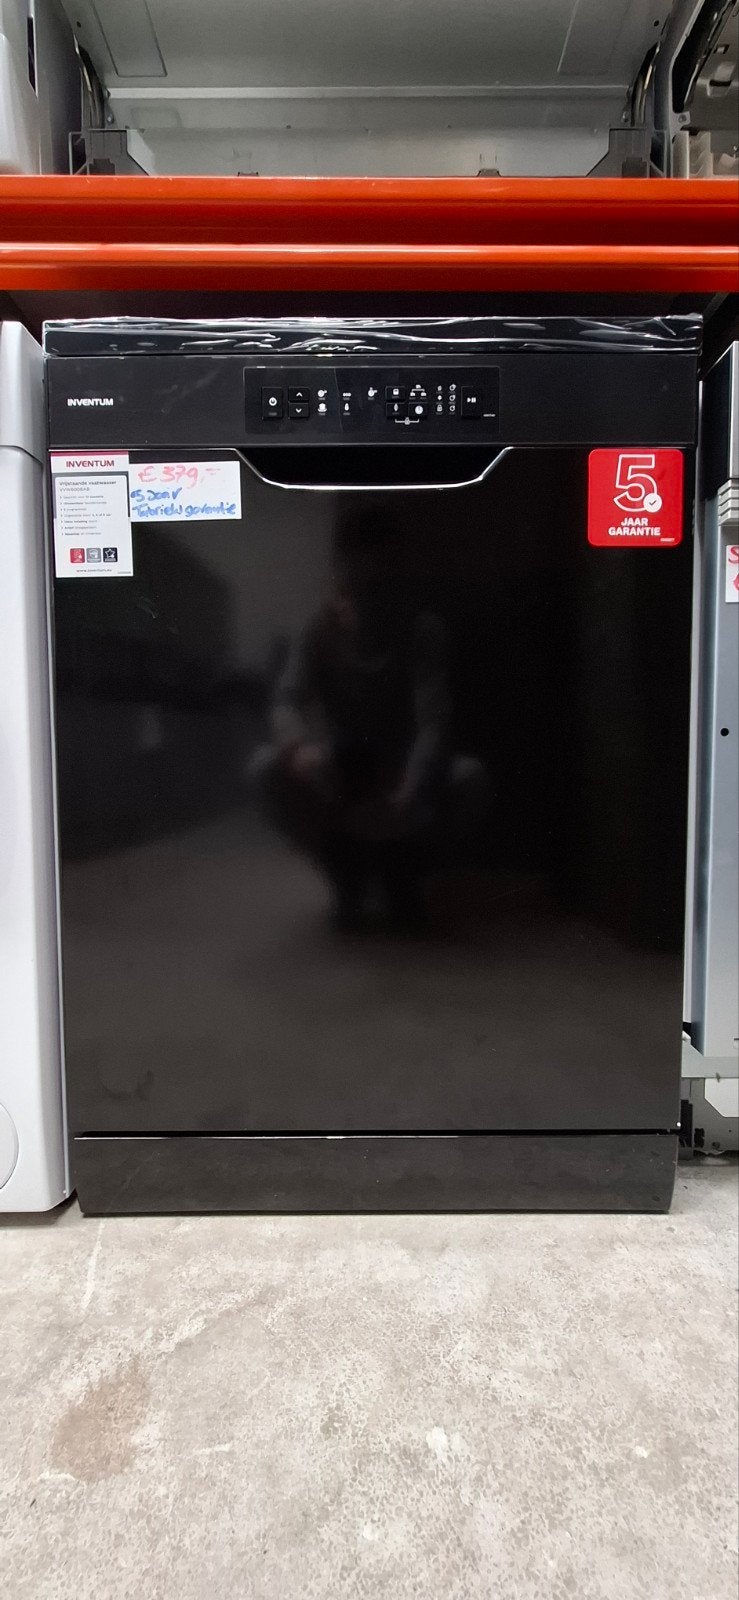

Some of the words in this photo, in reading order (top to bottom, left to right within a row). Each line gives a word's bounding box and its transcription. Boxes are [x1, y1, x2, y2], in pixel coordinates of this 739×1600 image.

[67, 398, 114, 407] INVENTUM
[65, 459, 115, 468] INVENTUM
[613, 454, 659, 512] 5
[620, 517, 649, 527] JAAR
[608, 527, 661, 536] GARANTIE
